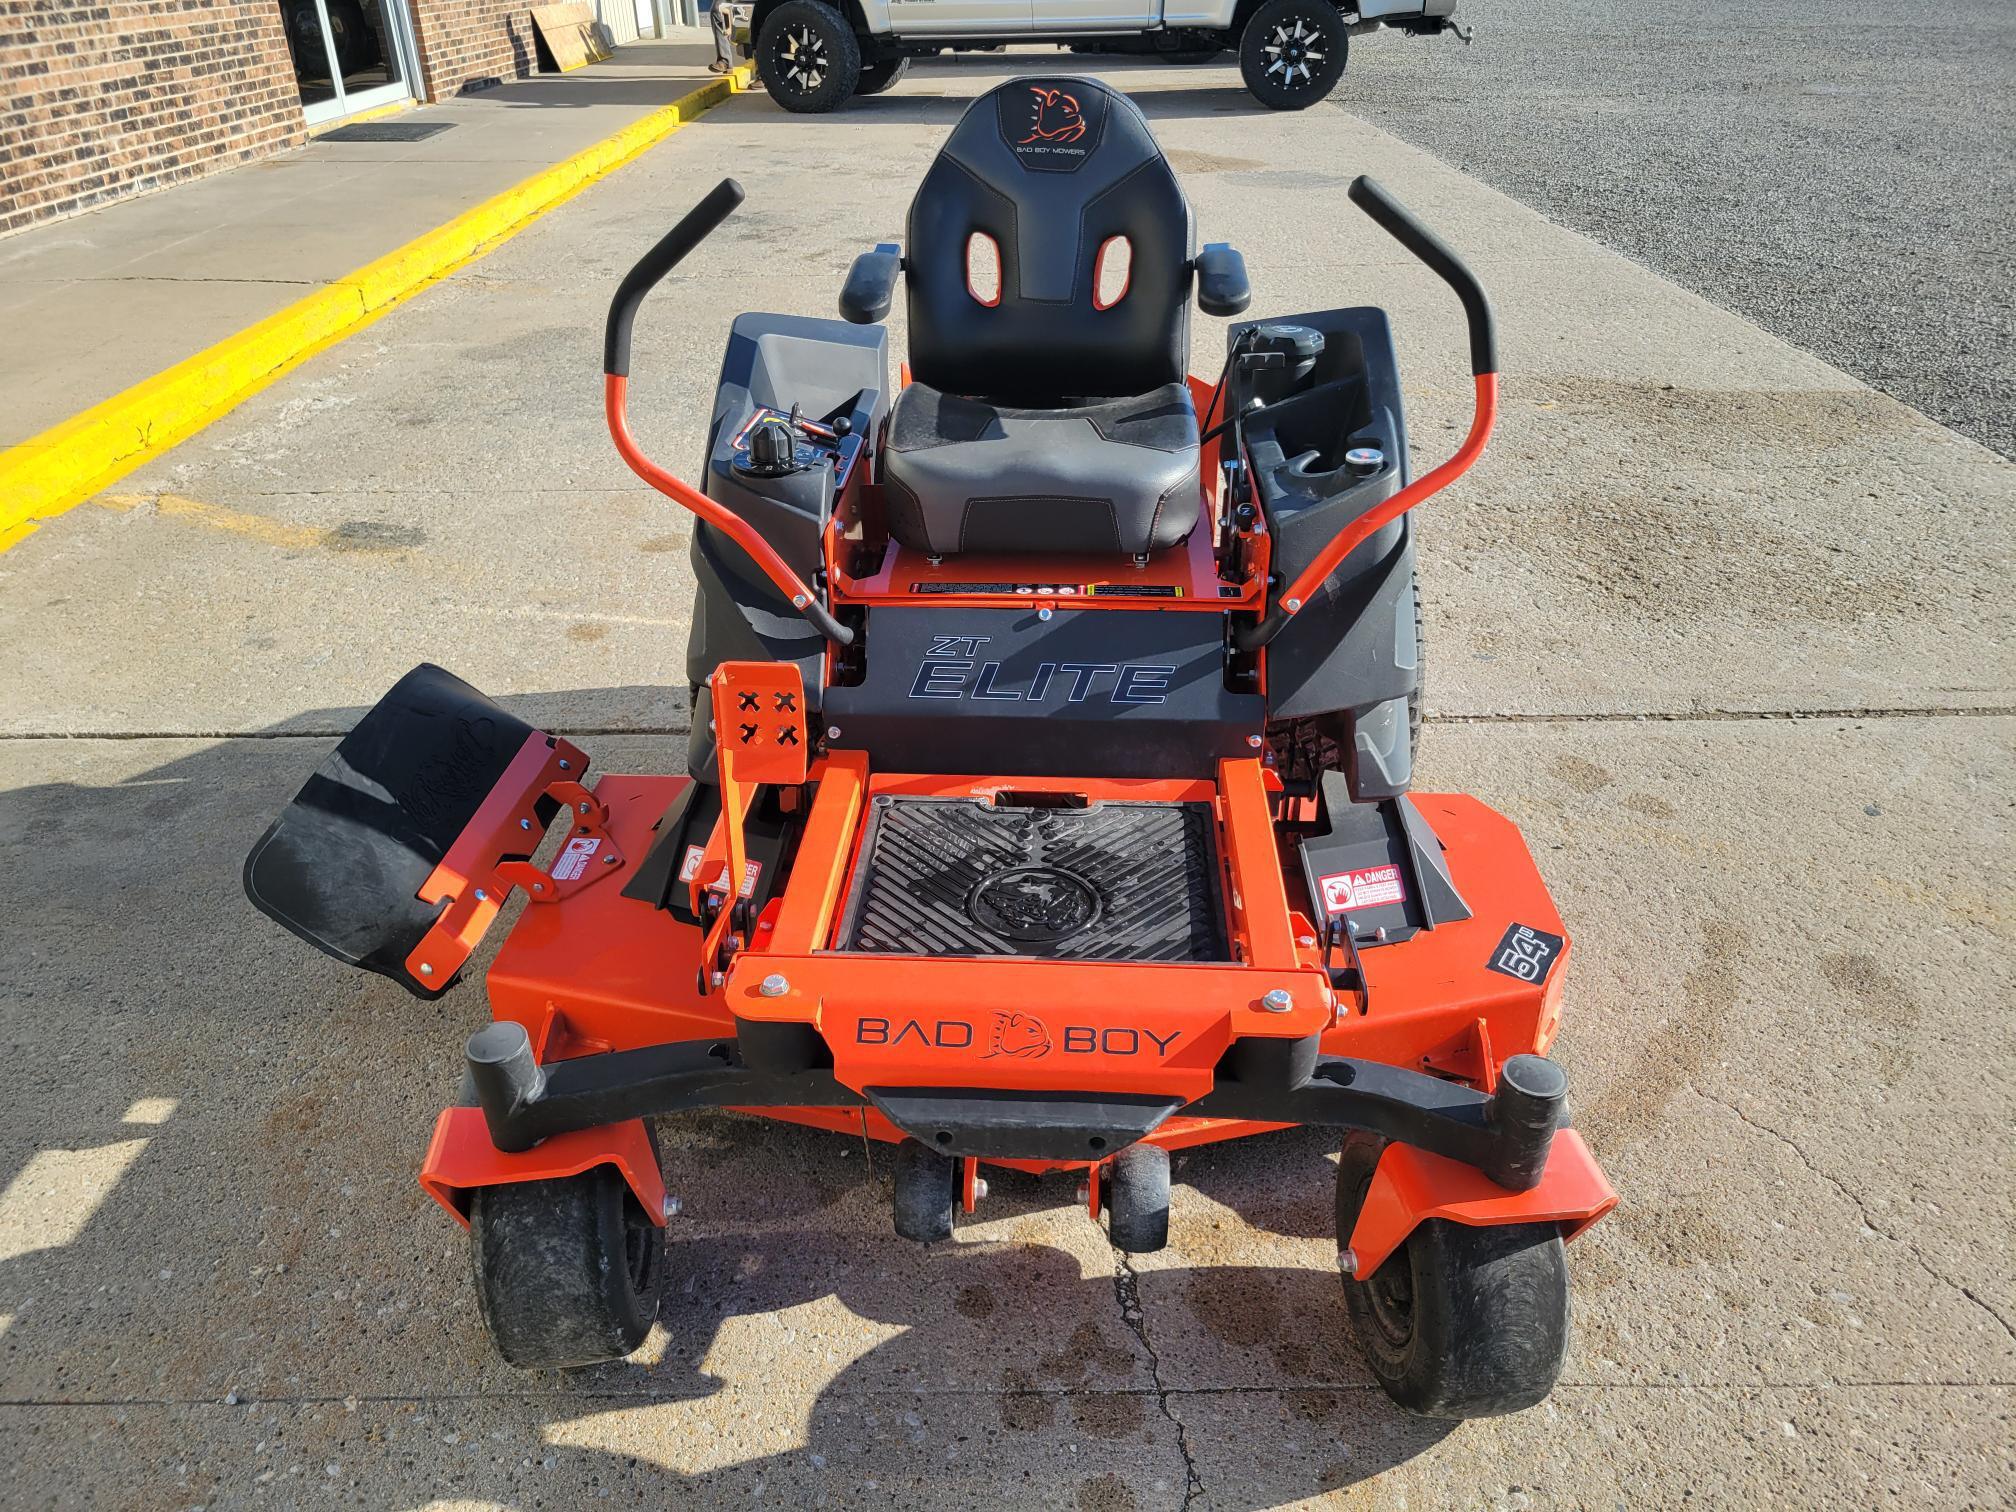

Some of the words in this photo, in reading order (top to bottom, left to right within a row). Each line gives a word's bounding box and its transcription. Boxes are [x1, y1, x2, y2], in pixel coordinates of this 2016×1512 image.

[1034, 146, 1051, 154] BOY
[925, 635, 992, 657] ZT
[908, 660, 1177, 704] ELITE
[1364, 868, 1398, 884] DANGER
[855, 1017, 973, 1048] BAD
[1063, 1025, 1182, 1057] BOY
